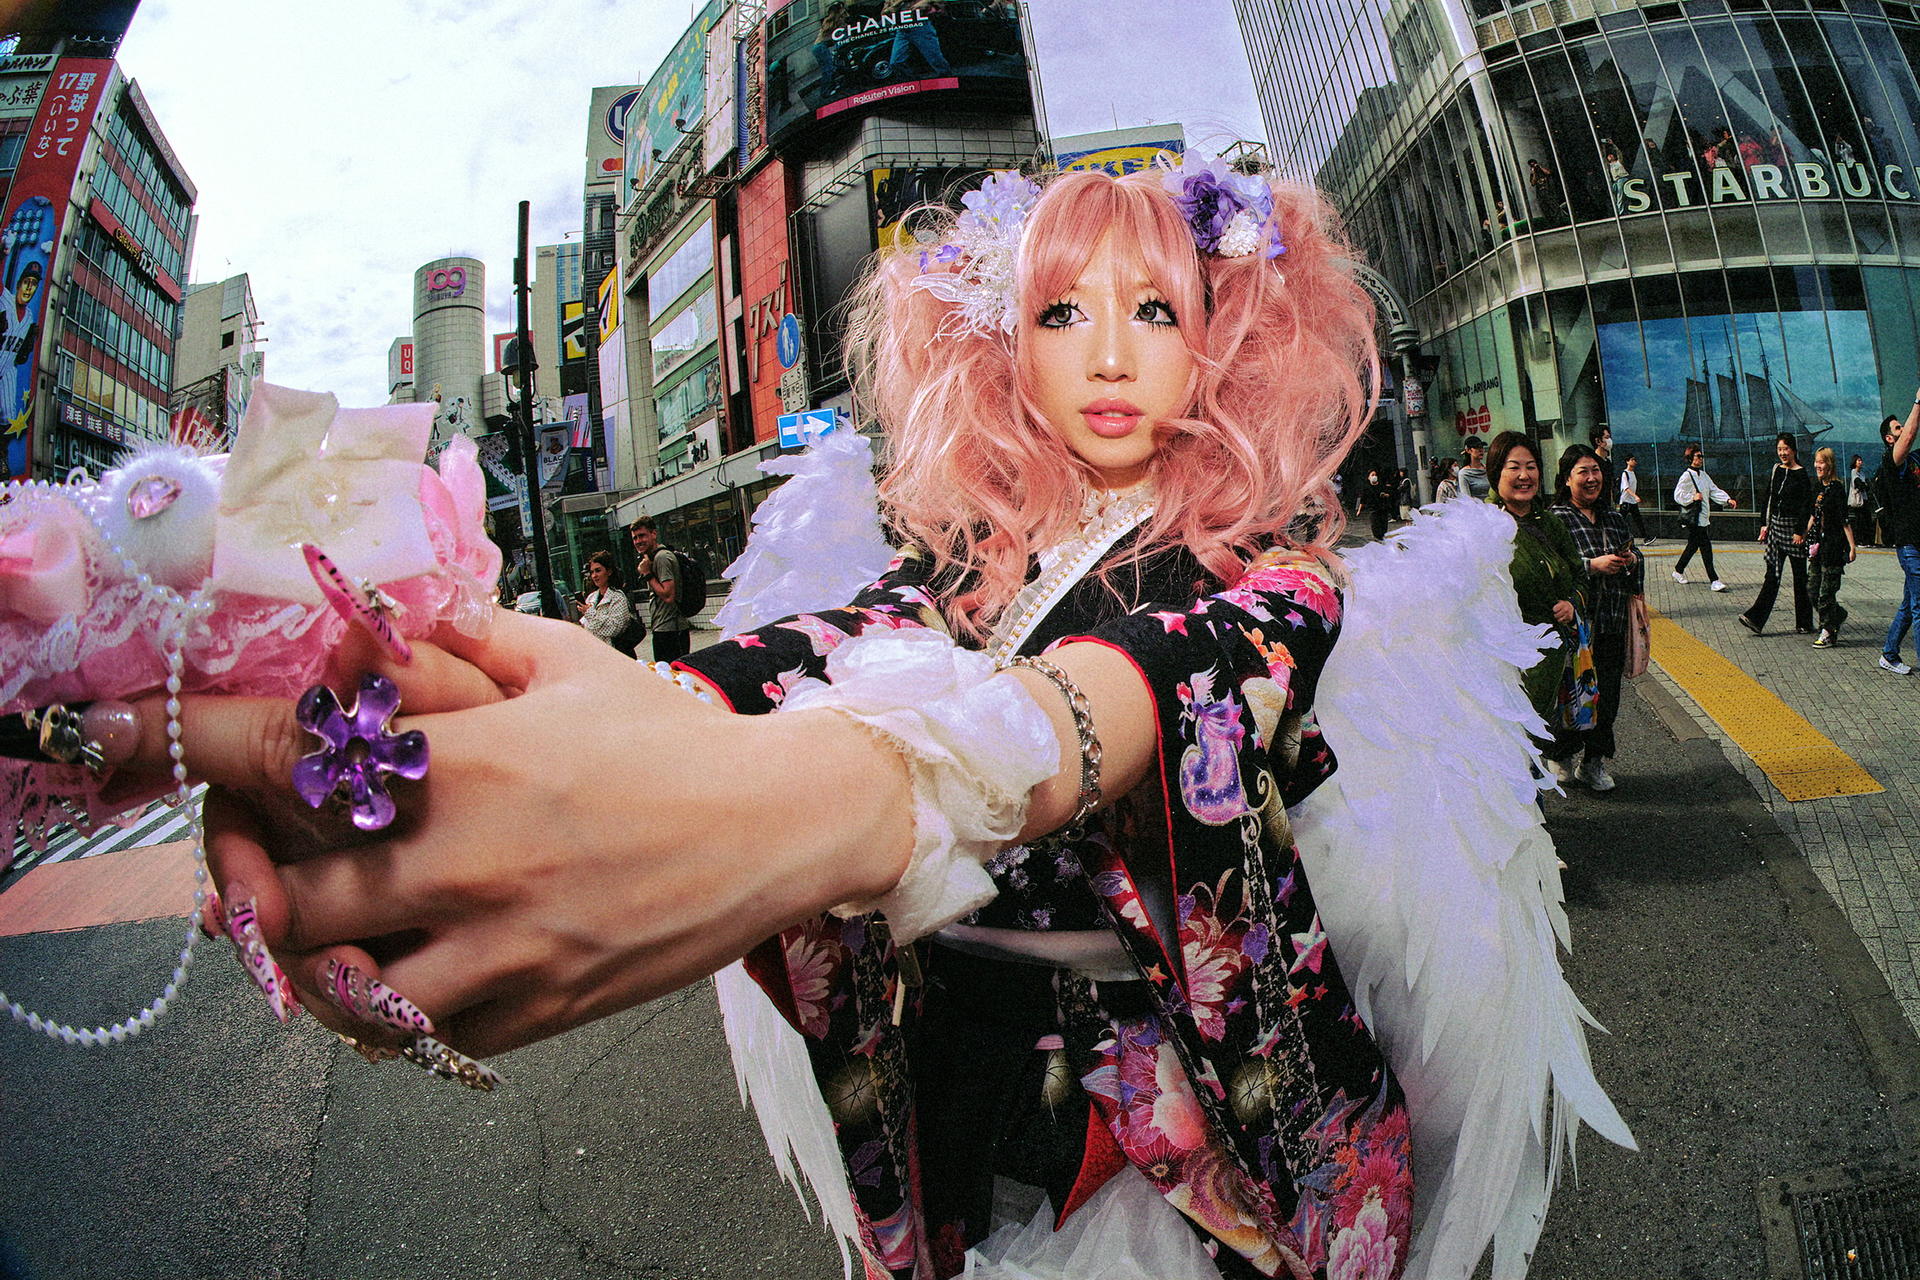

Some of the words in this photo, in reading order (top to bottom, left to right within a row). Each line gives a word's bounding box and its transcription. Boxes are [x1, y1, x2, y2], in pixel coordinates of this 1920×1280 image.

[831, 9, 929, 41] CHANEL
[837, 38, 851, 46] THE
[850, 30, 878, 41] CHANEL
[889, 22, 924, 32] HANDBAG
[853, 90, 887, 104] Rakuten
[888, 84, 915, 96] Vision
[57, 73, 97, 156] 野球って
[1622, 163, 1920, 213] STARBUC
[425, 267, 466, 297] 109
